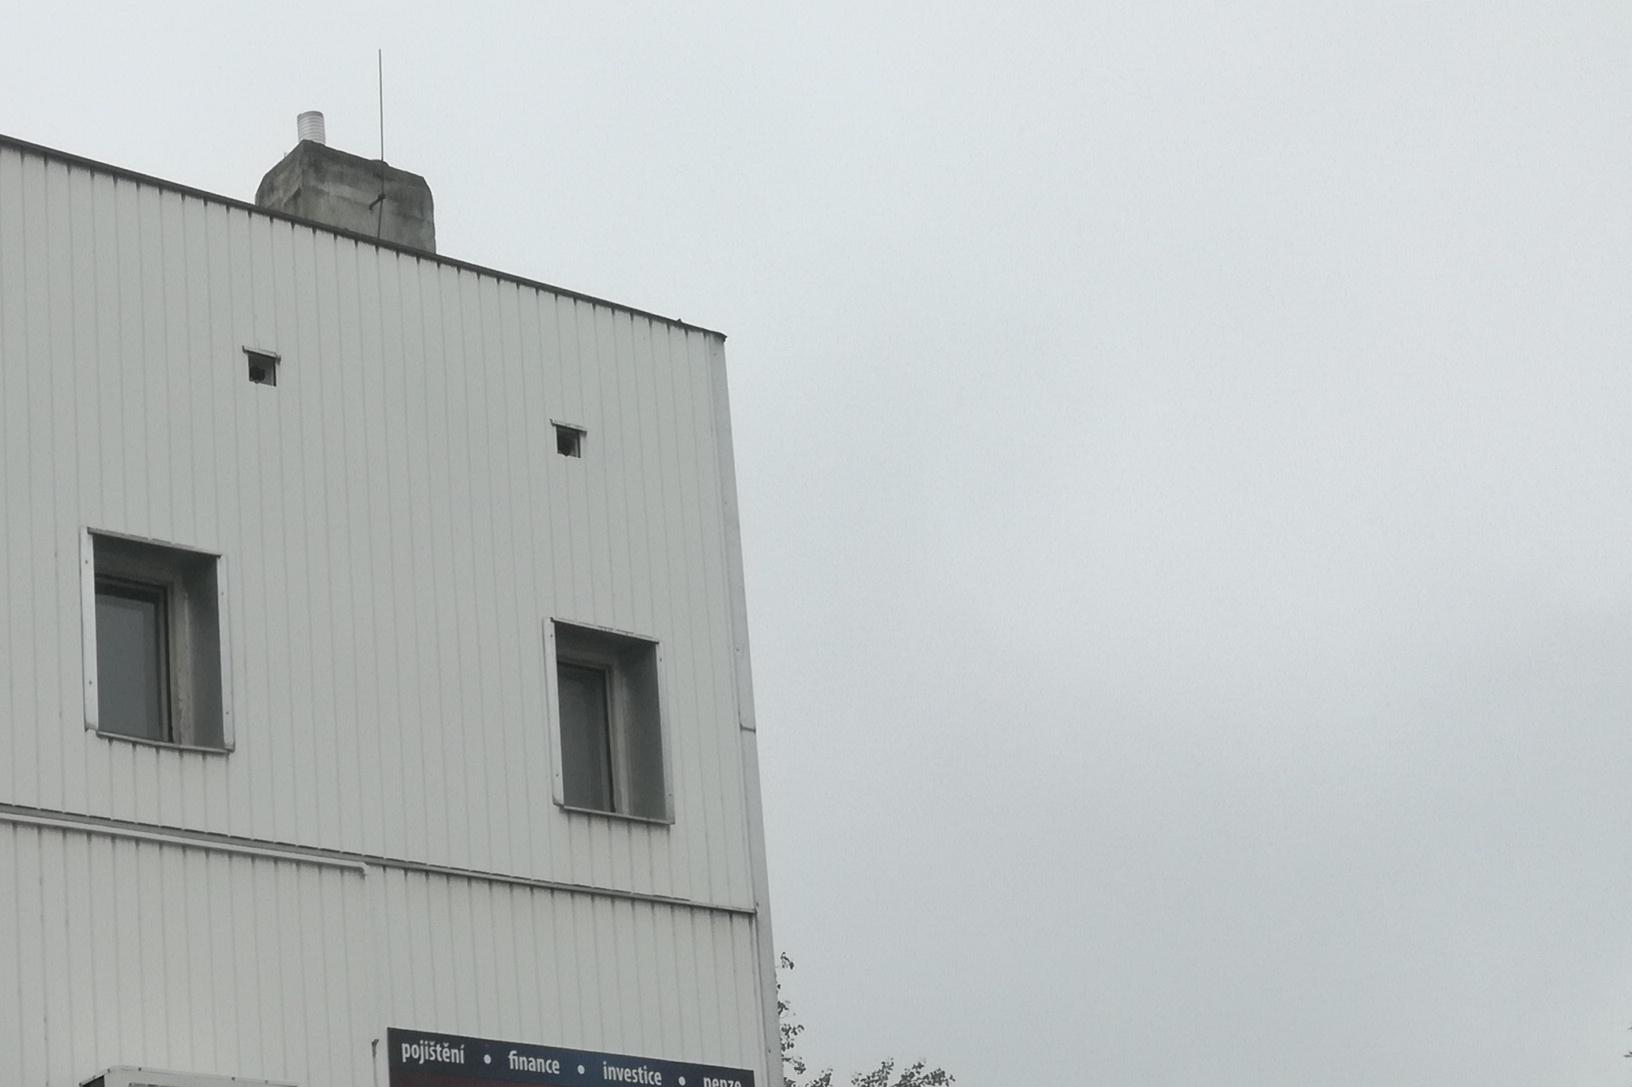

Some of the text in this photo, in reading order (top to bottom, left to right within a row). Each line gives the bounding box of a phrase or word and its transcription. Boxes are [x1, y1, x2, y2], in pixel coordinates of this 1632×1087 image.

[401, 1039, 465, 1064] pojištění
[508, 1050, 560, 1075] finance
[603, 1061, 662, 1086] investice
